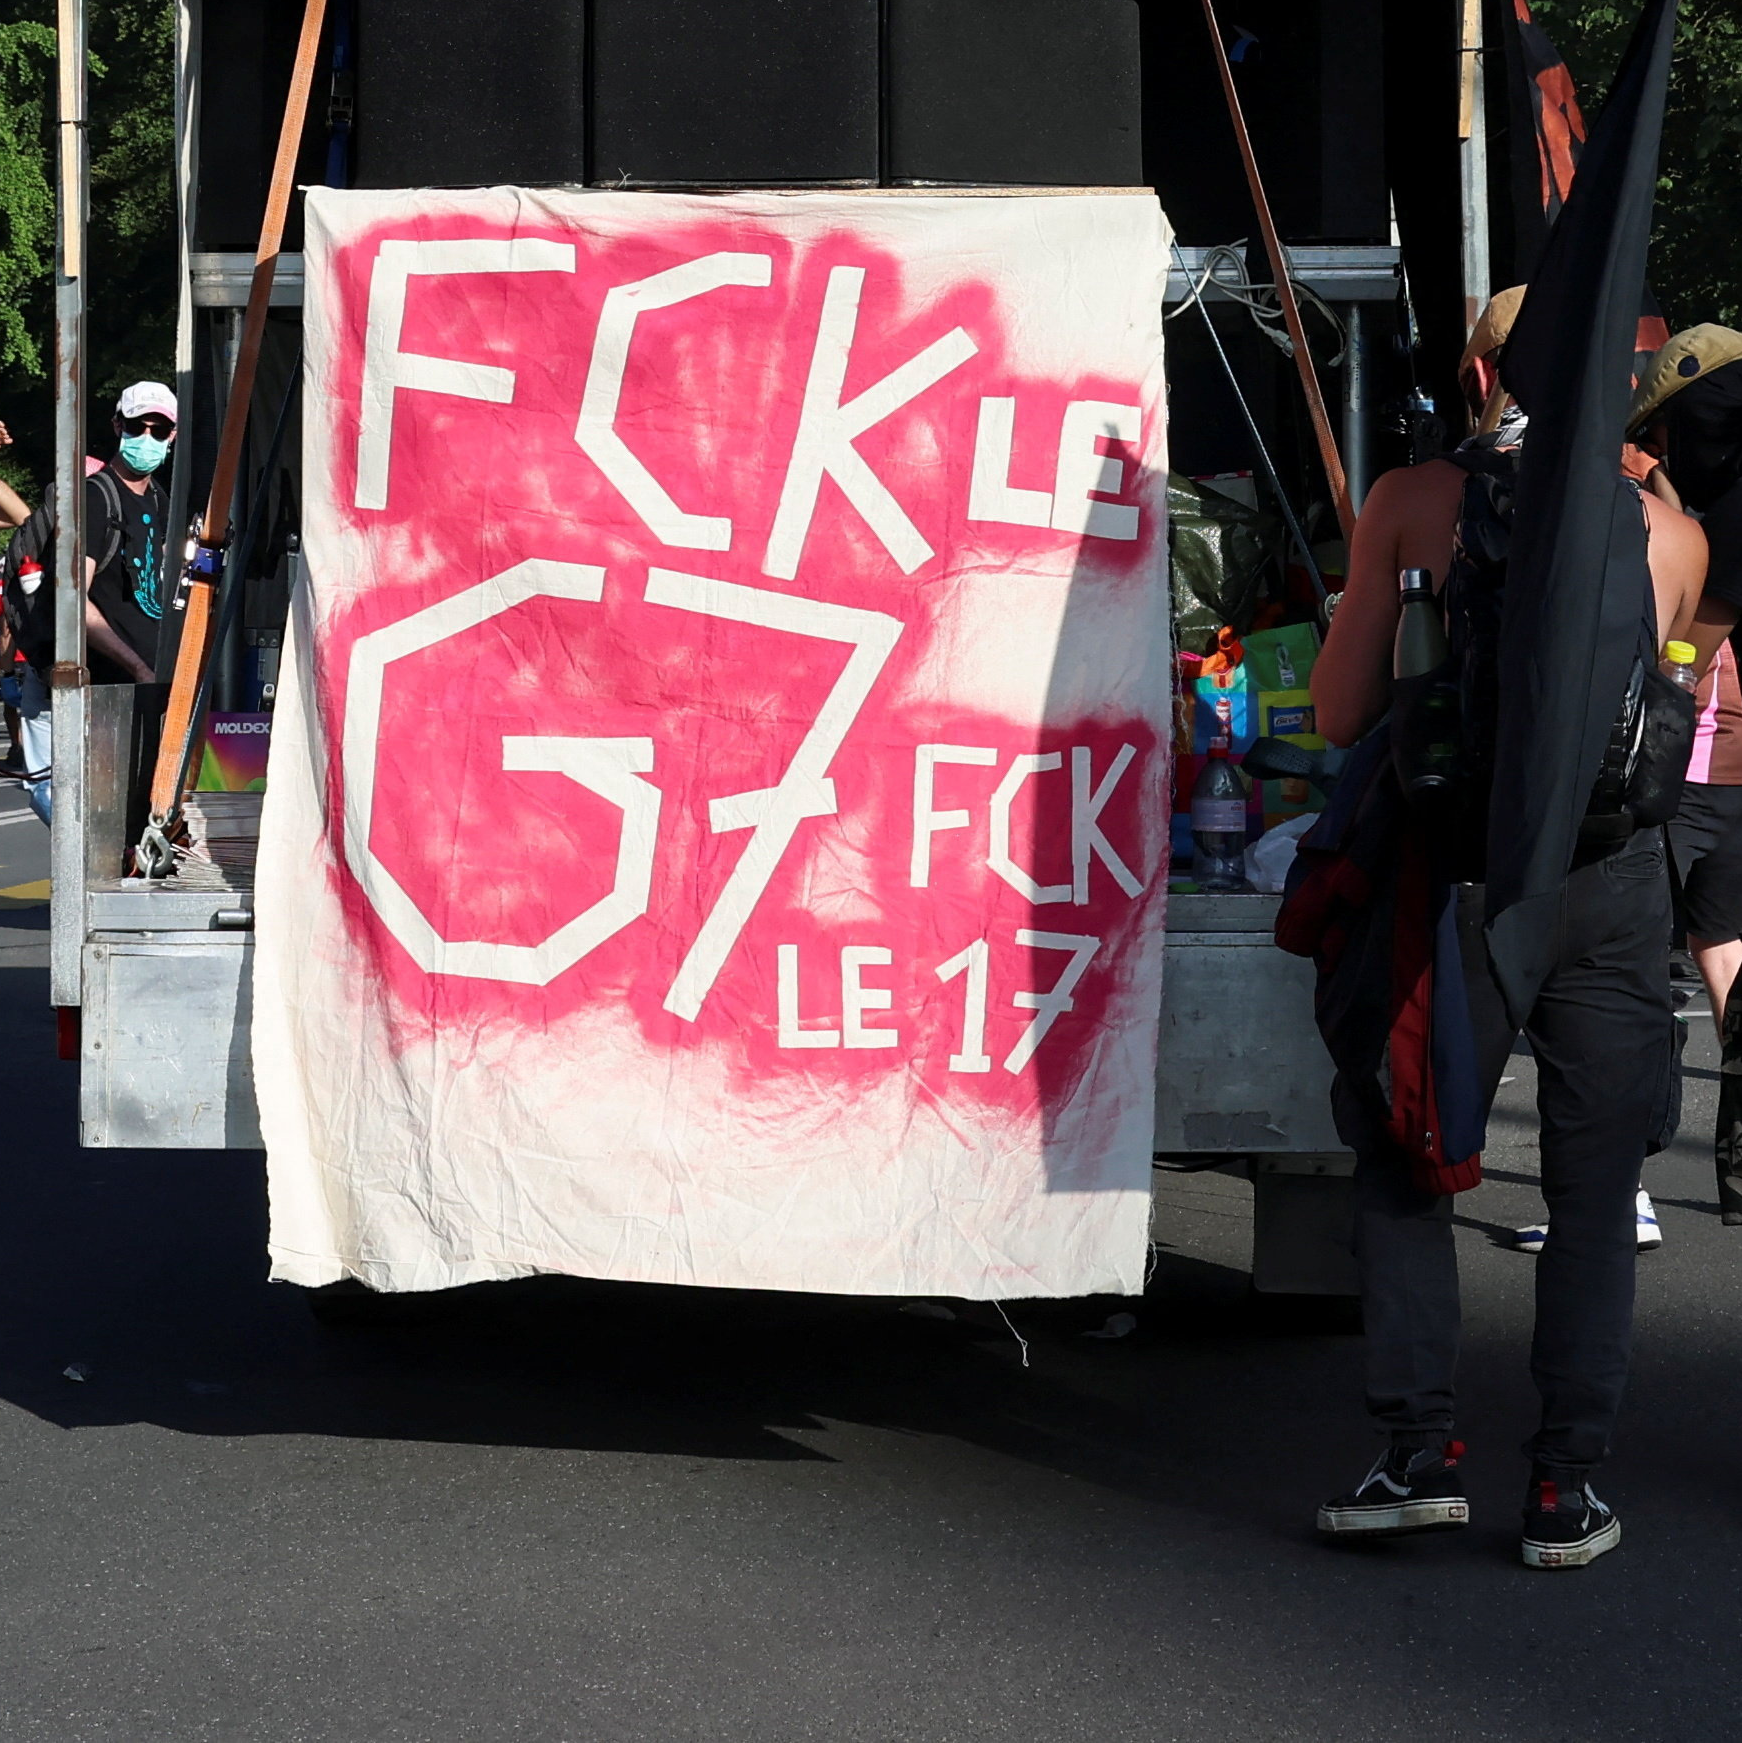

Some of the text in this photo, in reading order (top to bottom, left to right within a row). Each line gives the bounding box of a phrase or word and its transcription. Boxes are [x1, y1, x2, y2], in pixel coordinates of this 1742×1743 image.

[354, 237, 1141, 580] FCK LE
[214, 722, 271, 735] MOLDEX
[342, 557, 905, 1024] G7
[910, 744, 1144, 906] FCK
[777, 929, 1100, 1075] LE 17
